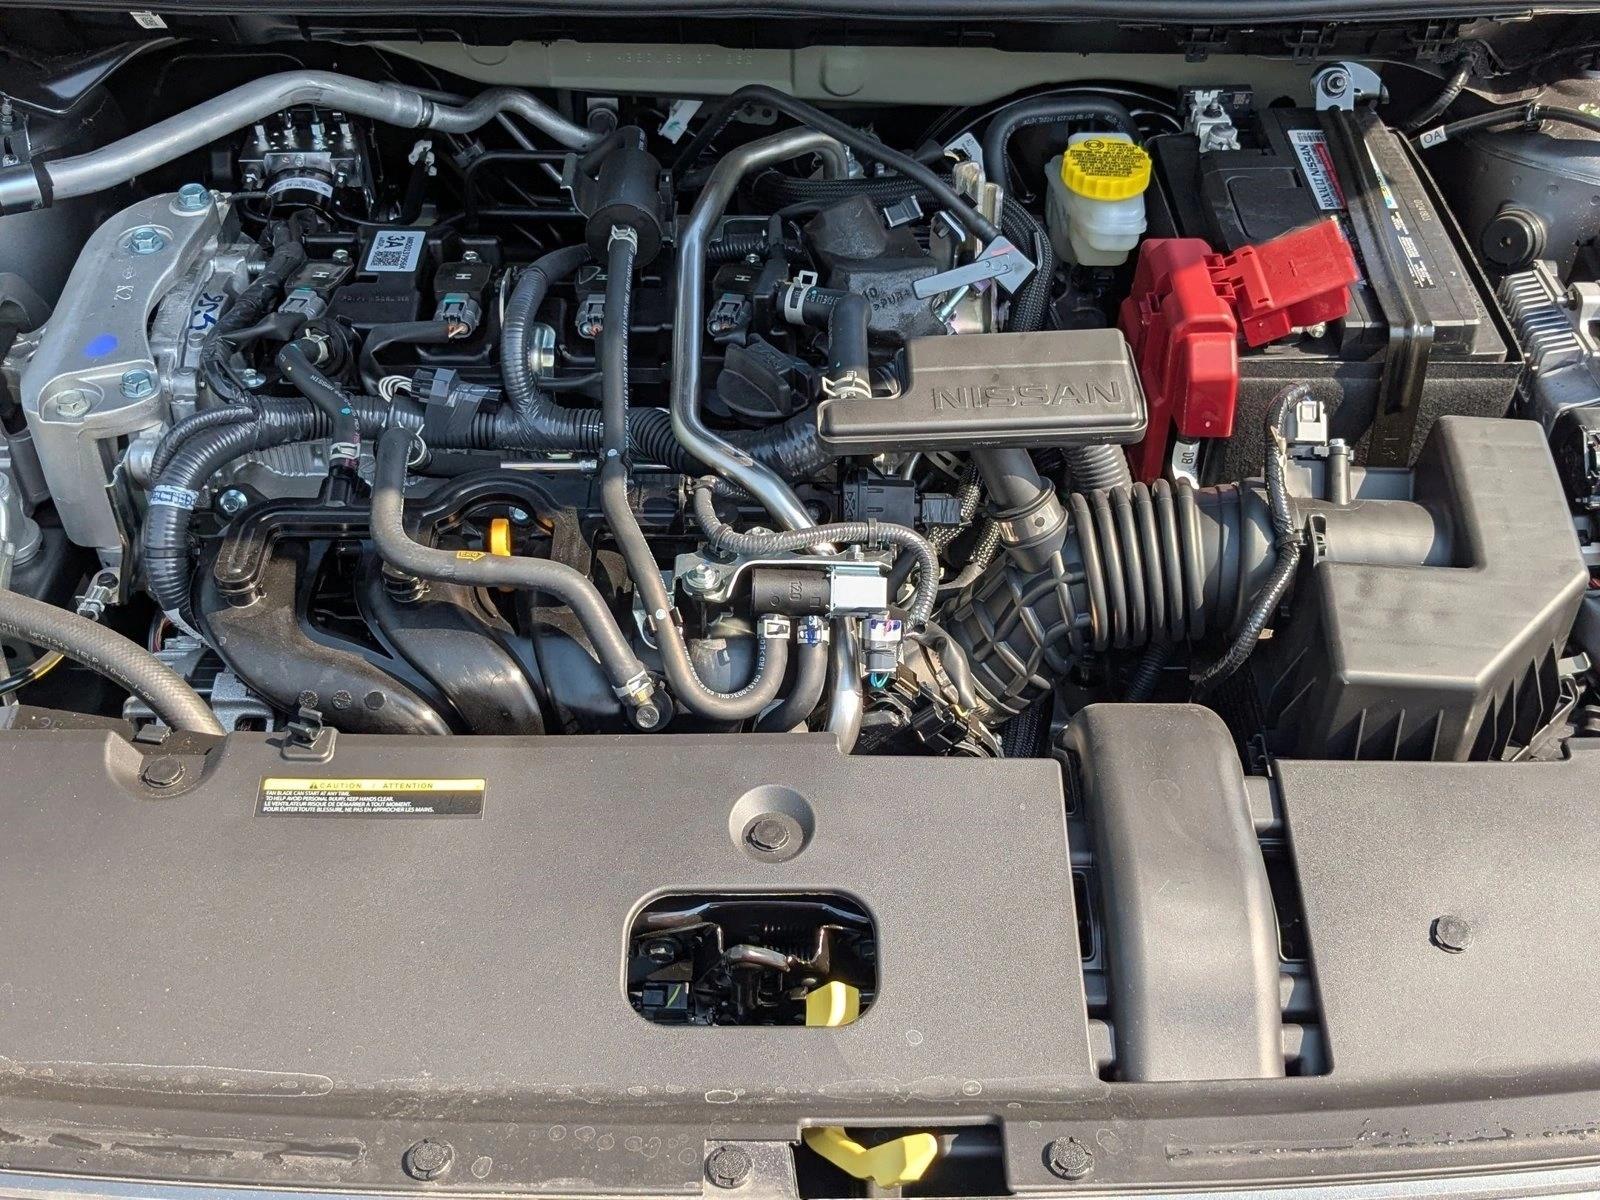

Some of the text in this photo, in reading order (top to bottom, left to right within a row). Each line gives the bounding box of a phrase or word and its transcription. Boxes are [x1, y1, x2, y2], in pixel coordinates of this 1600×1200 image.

[1298, 143, 1322, 177] NISSAN
[1312, 177, 1336, 209] RENAULT
[384, 235, 406, 249] 3A
[931, 379, 1126, 410] NISSAN
